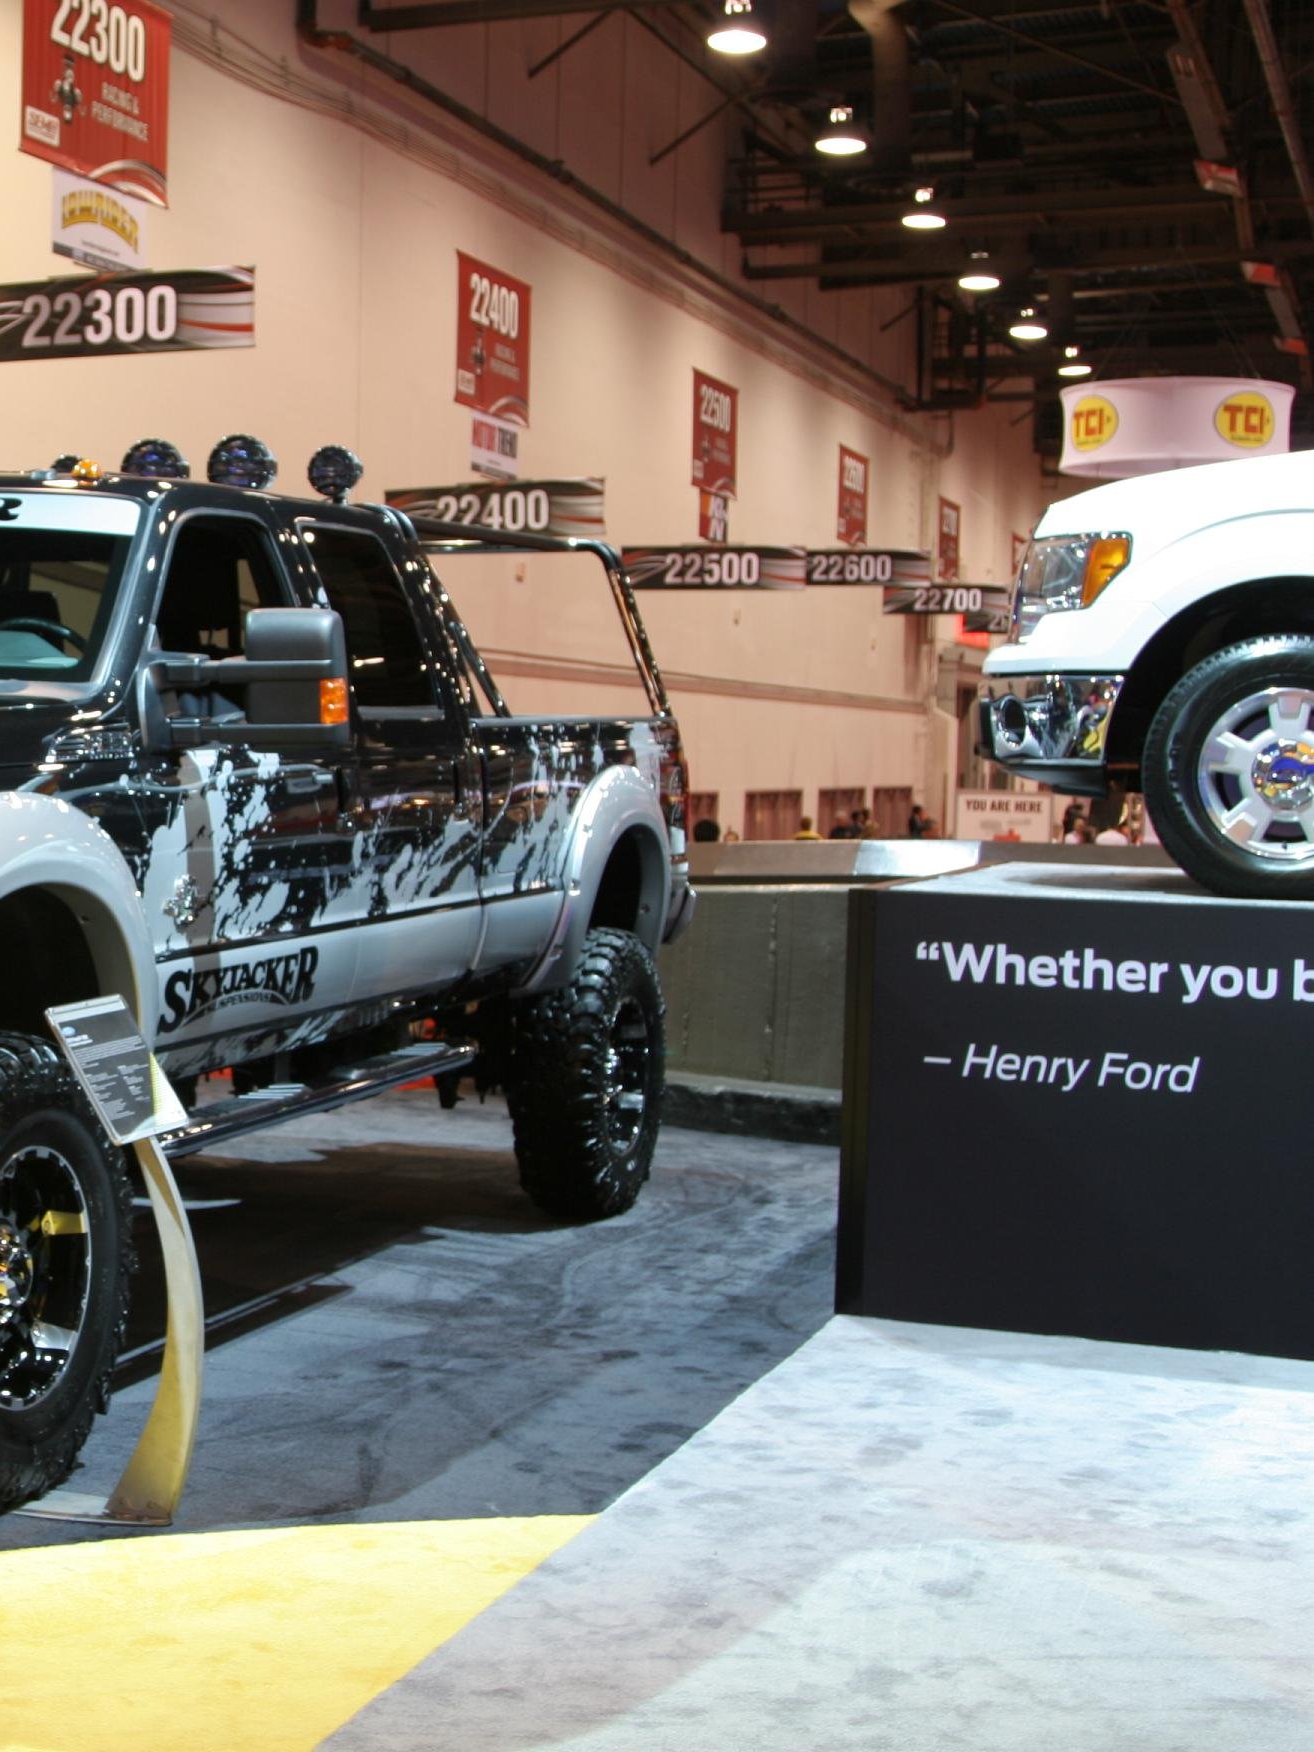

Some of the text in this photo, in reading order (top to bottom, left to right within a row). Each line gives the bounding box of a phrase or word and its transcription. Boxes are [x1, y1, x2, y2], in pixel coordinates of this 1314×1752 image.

[51, 0, 145, 82] 22300
[21, 285, 177, 347] 22300
[470, 272, 519, 339] 22400
[700, 384, 731, 433] 22500
[1073, 407, 1104, 437] TCI
[1223, 404, 1266, 434] TCI
[438, 490, 549, 530] 22400
[664, 551, 760, 585] 22500
[811, 554, 891, 582] 22600
[914, 588, 982, 612] 22700
[966, 800, 1043, 813] YOU ARE HERE
[157, 946, 319, 1034] SKYJACKER
[916, 941, 1169, 993] “Whether
[1180, 963, 1278, 1003] you
[962, 1043, 1090, 1092] Henry
[1097, 1052, 1200, 1093] Ford
